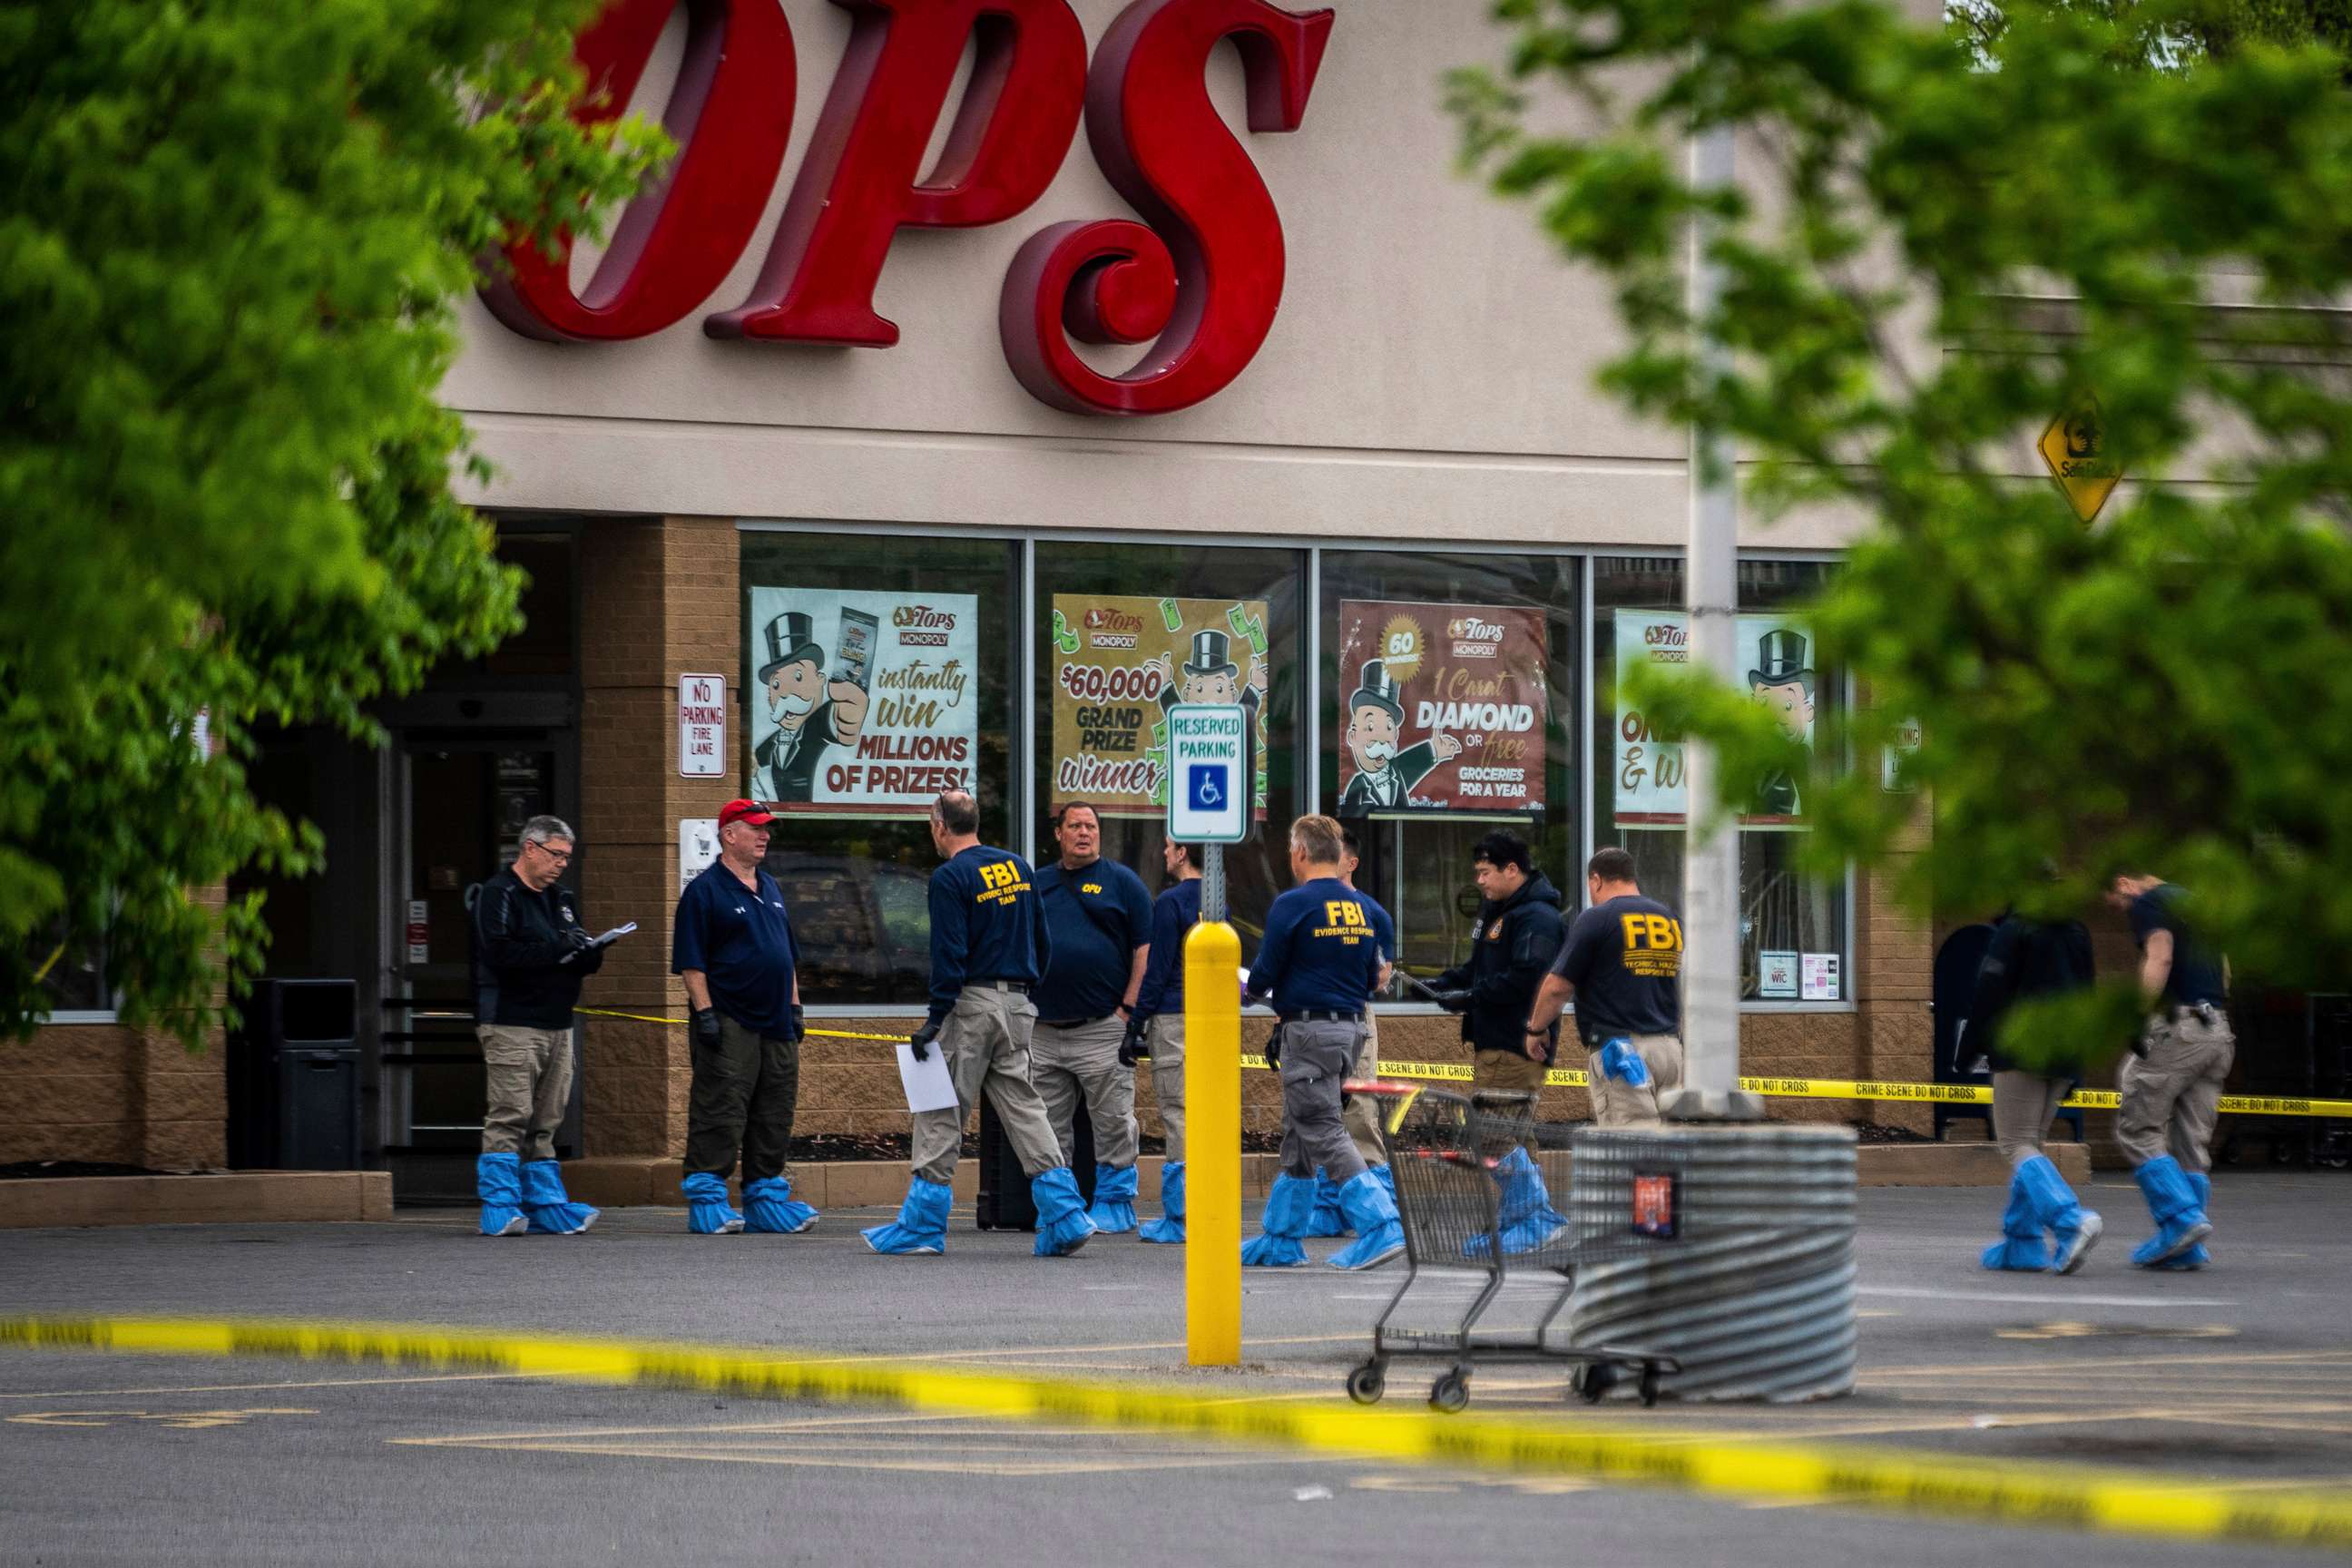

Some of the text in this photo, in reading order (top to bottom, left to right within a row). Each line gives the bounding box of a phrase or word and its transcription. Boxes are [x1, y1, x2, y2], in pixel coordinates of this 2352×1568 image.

[901, 634, 947, 645] MONOPOLY
[1093, 636, 1136, 647] MONOPOLY
[1453, 644, 1496, 655] MONOPOLY
[877, 659, 967, 708] instantly
[1060, 663, 1162, 705] $60,000
[693, 684, 711, 703] NO
[682, 706, 723, 726] PARKING
[1076, 706, 1142, 729] GRAND
[1416, 701, 1534, 731] DIAMOND
[693, 727, 712, 740] FIRE
[1174, 718, 1240, 736] RESERVED
[857, 735, 969, 762] MILLIONS
[1081, 730, 1137, 751] PRIZE
[691, 743, 714, 756] LANE
[1180, 741, 1237, 759] PARKING
[1465, 730, 1529, 769] OR free
[827, 764, 970, 794] OF PRIZES!
[1458, 767, 1525, 781] GROCERIES
[1459, 782, 1526, 798] FOR A YEAR
[978, 859, 1022, 890] FBI
[1325, 900, 1367, 926] FBI
[1314, 927, 1349, 937] EVIDENCE
[1621, 913, 1683, 953] FBI
[1342, 936, 1360, 945] TEAM
[1771, 973, 1788, 984] WIC
[1249, 1055, 1259, 1065] DO
[1385, 1063, 1413, 1074] SCENE
[1415, 1063, 1427, 1075] DO
[1429, 1064, 1446, 1076] NOT
[1448, 1065, 1475, 1077] CROSS
[1552, 1071, 1581, 1083] SCENE
[1749, 1079, 1760, 1090] DO
[1762, 1079, 1779, 1091] NOT
[1781, 1080, 1809, 1093] CROSS
[1856, 1083, 1976, 1100] CRIME SCENE DO NOT CROSS
[2082, 1092, 2094, 1102] DO
[2096, 1093, 2114, 1103] NOT
[2220, 1097, 2311, 1112] SCENE DO NOT CROSS
